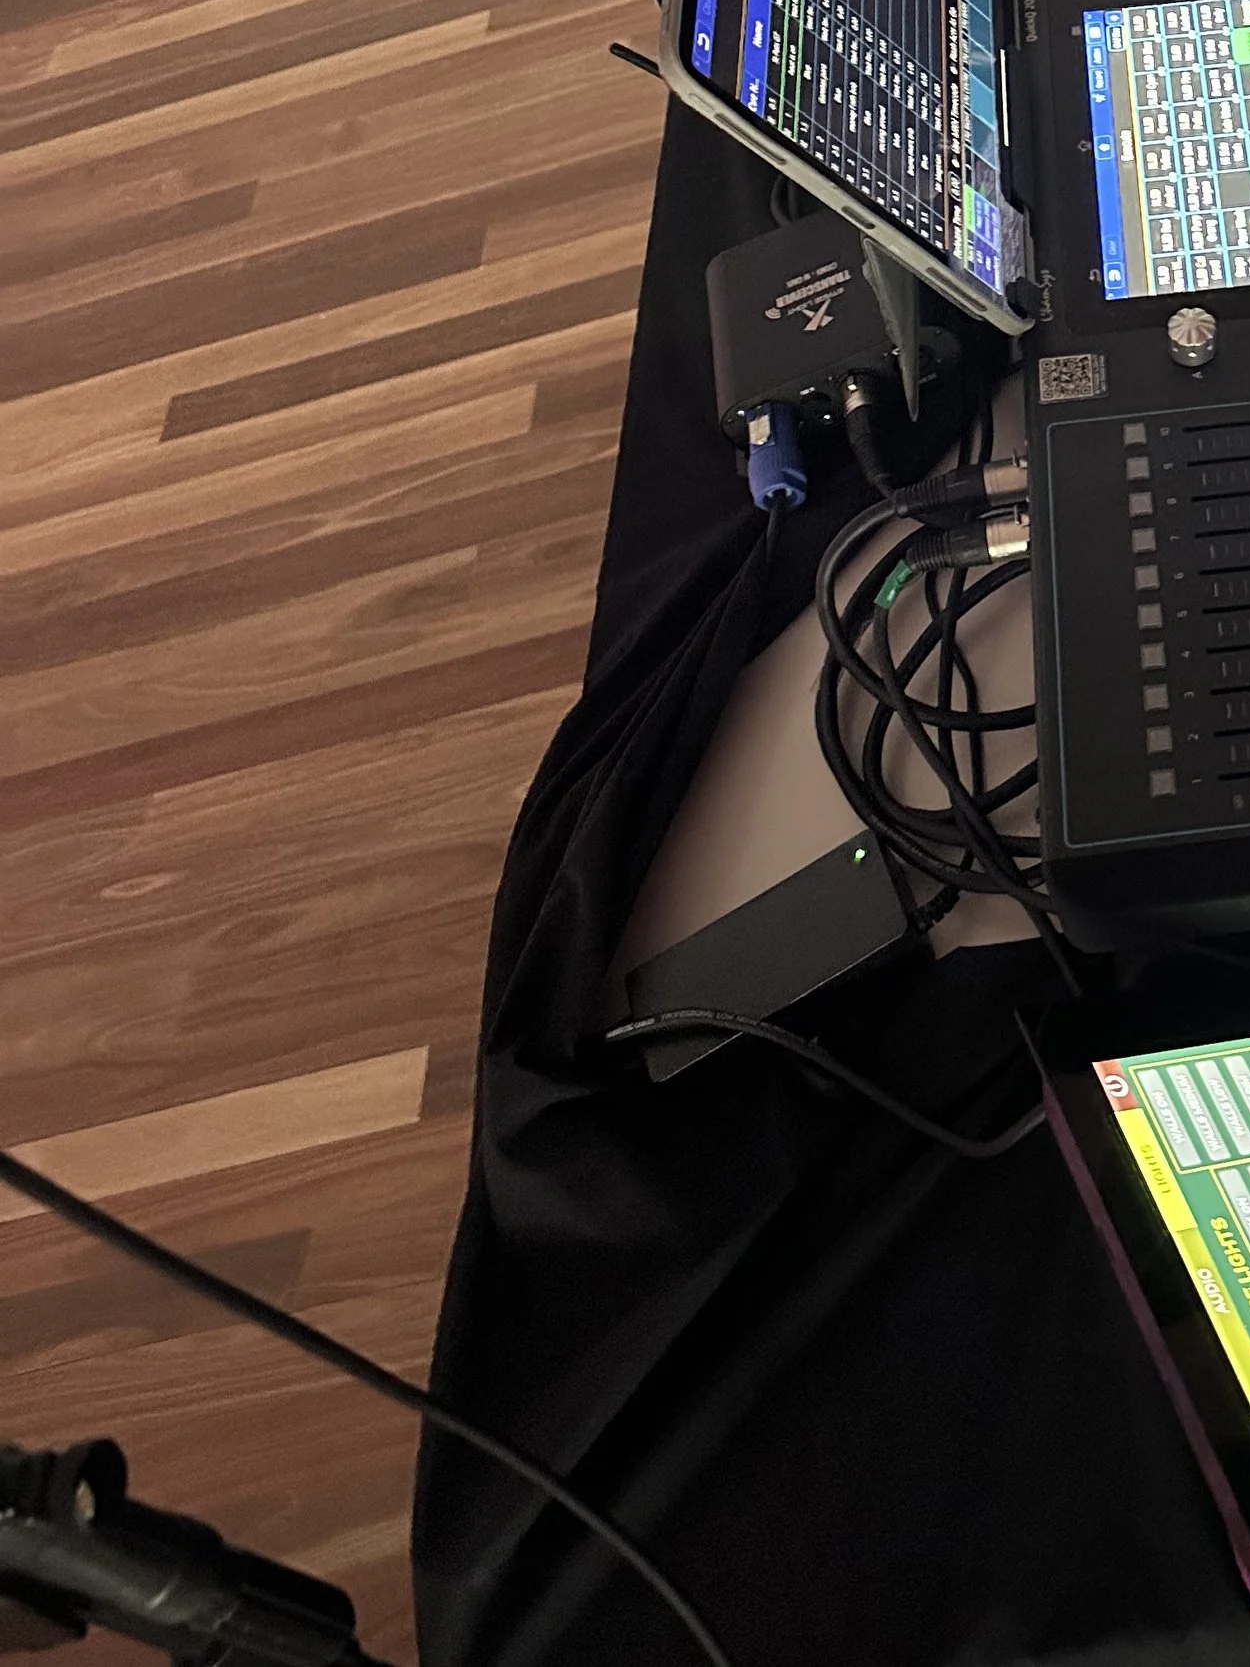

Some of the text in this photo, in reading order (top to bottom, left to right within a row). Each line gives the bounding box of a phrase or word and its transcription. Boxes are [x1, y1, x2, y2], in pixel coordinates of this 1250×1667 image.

[752, 17, 763, 50] Name
[1150, 1090, 1187, 1144] WALLS ON
[1174, 1072, 1223, 1150] WALLS MEDIUM
[1207, 1076, 1247, 1136] WALLS LOW
[1138, 1143, 1172, 1194] LIGHTS
[1196, 1266, 1231, 1315] AUDIO
